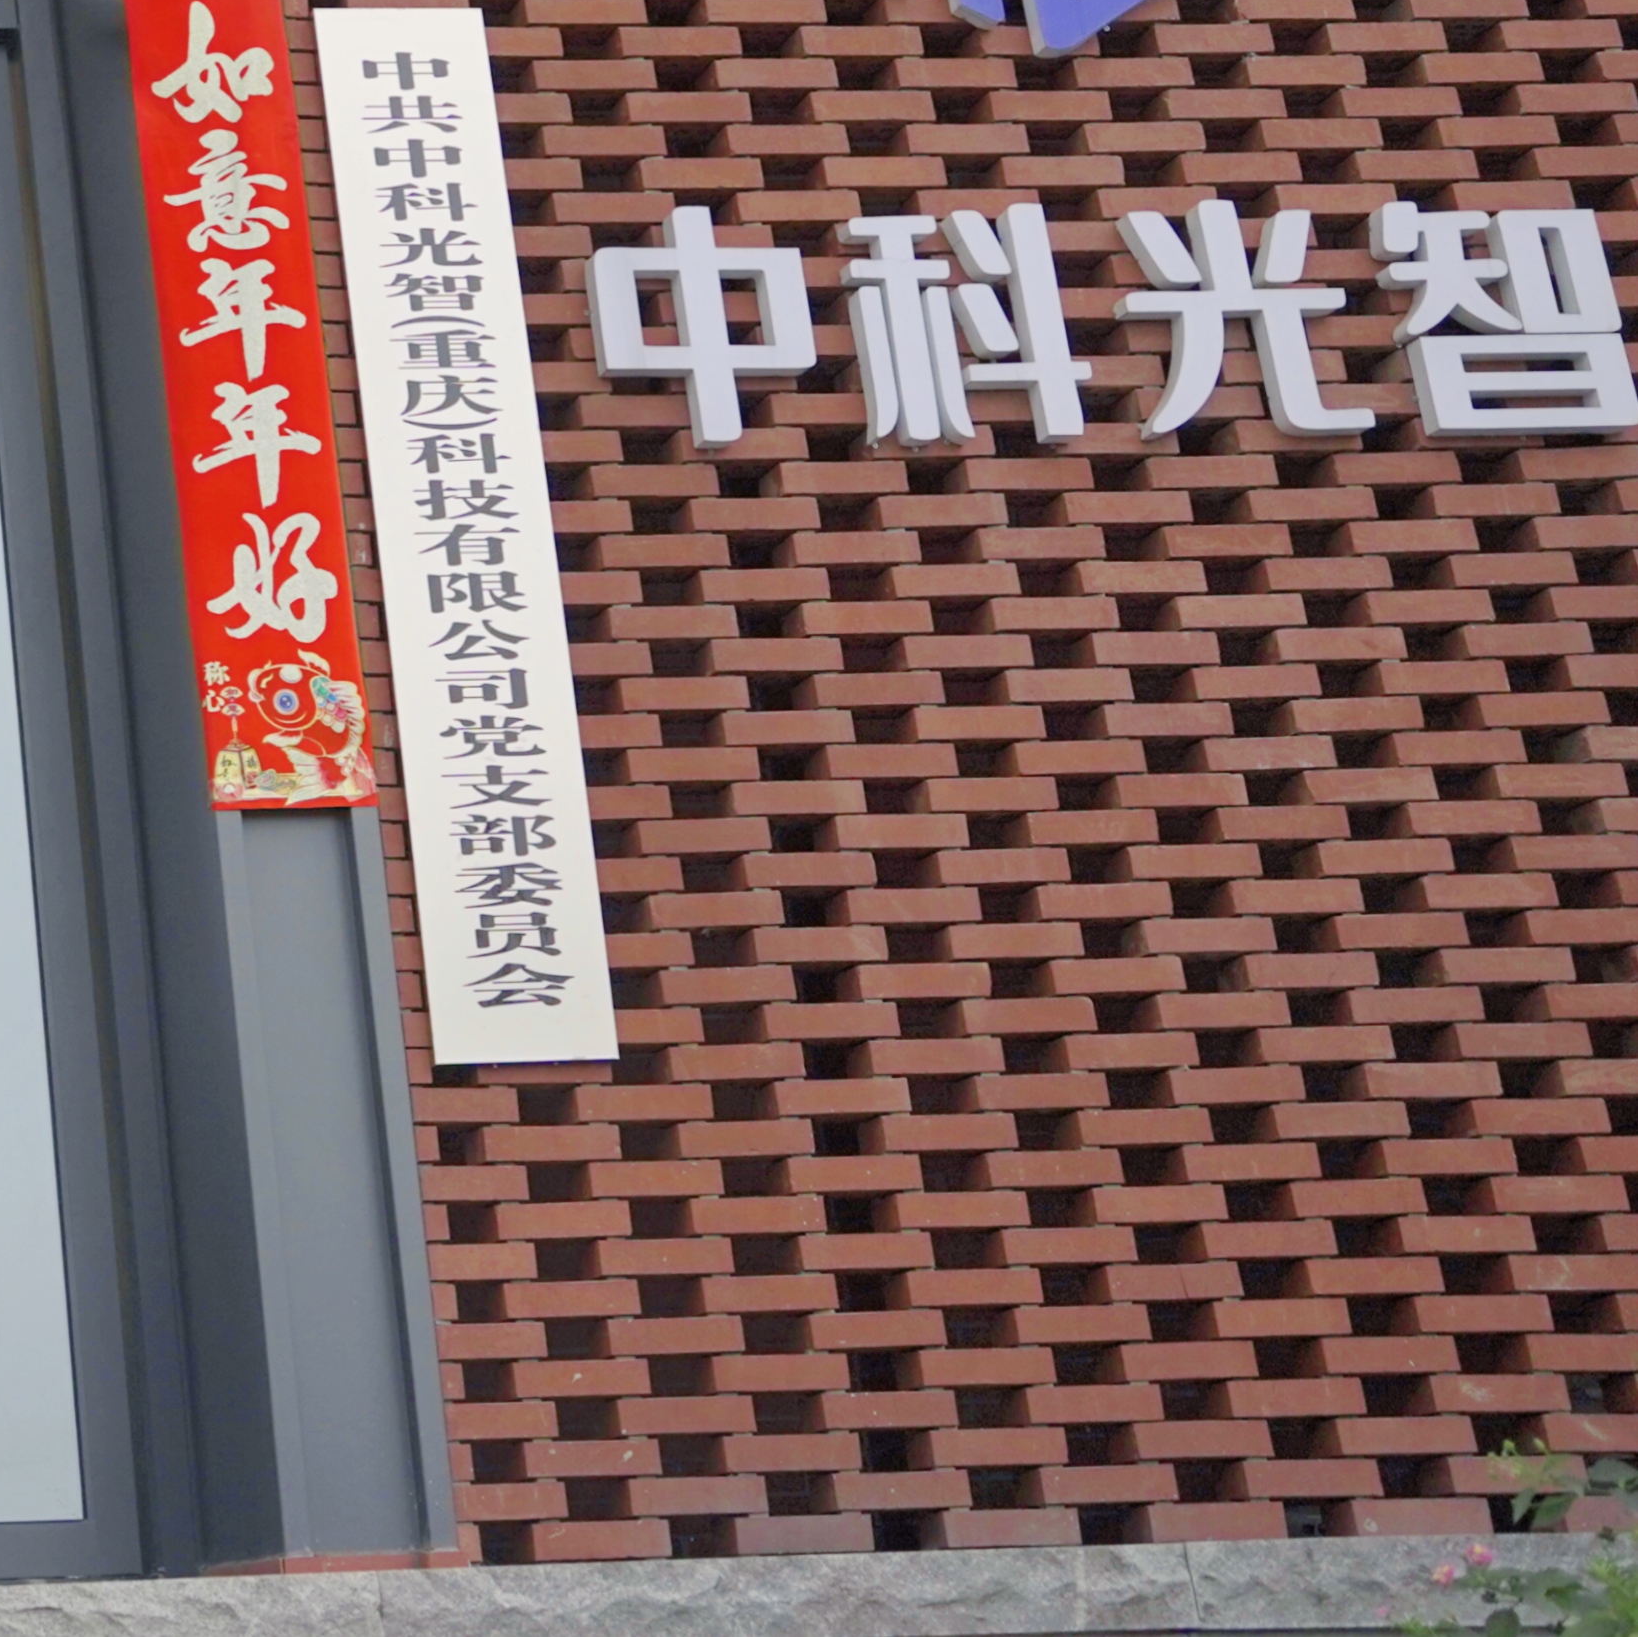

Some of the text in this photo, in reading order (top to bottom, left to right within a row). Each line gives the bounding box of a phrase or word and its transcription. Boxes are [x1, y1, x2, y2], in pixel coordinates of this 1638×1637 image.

[362, 52, 575, 1008] 中共中科光智（重庆）科技有限公司党支部委员会
[586, 200, 1638, 449] 中科光智
